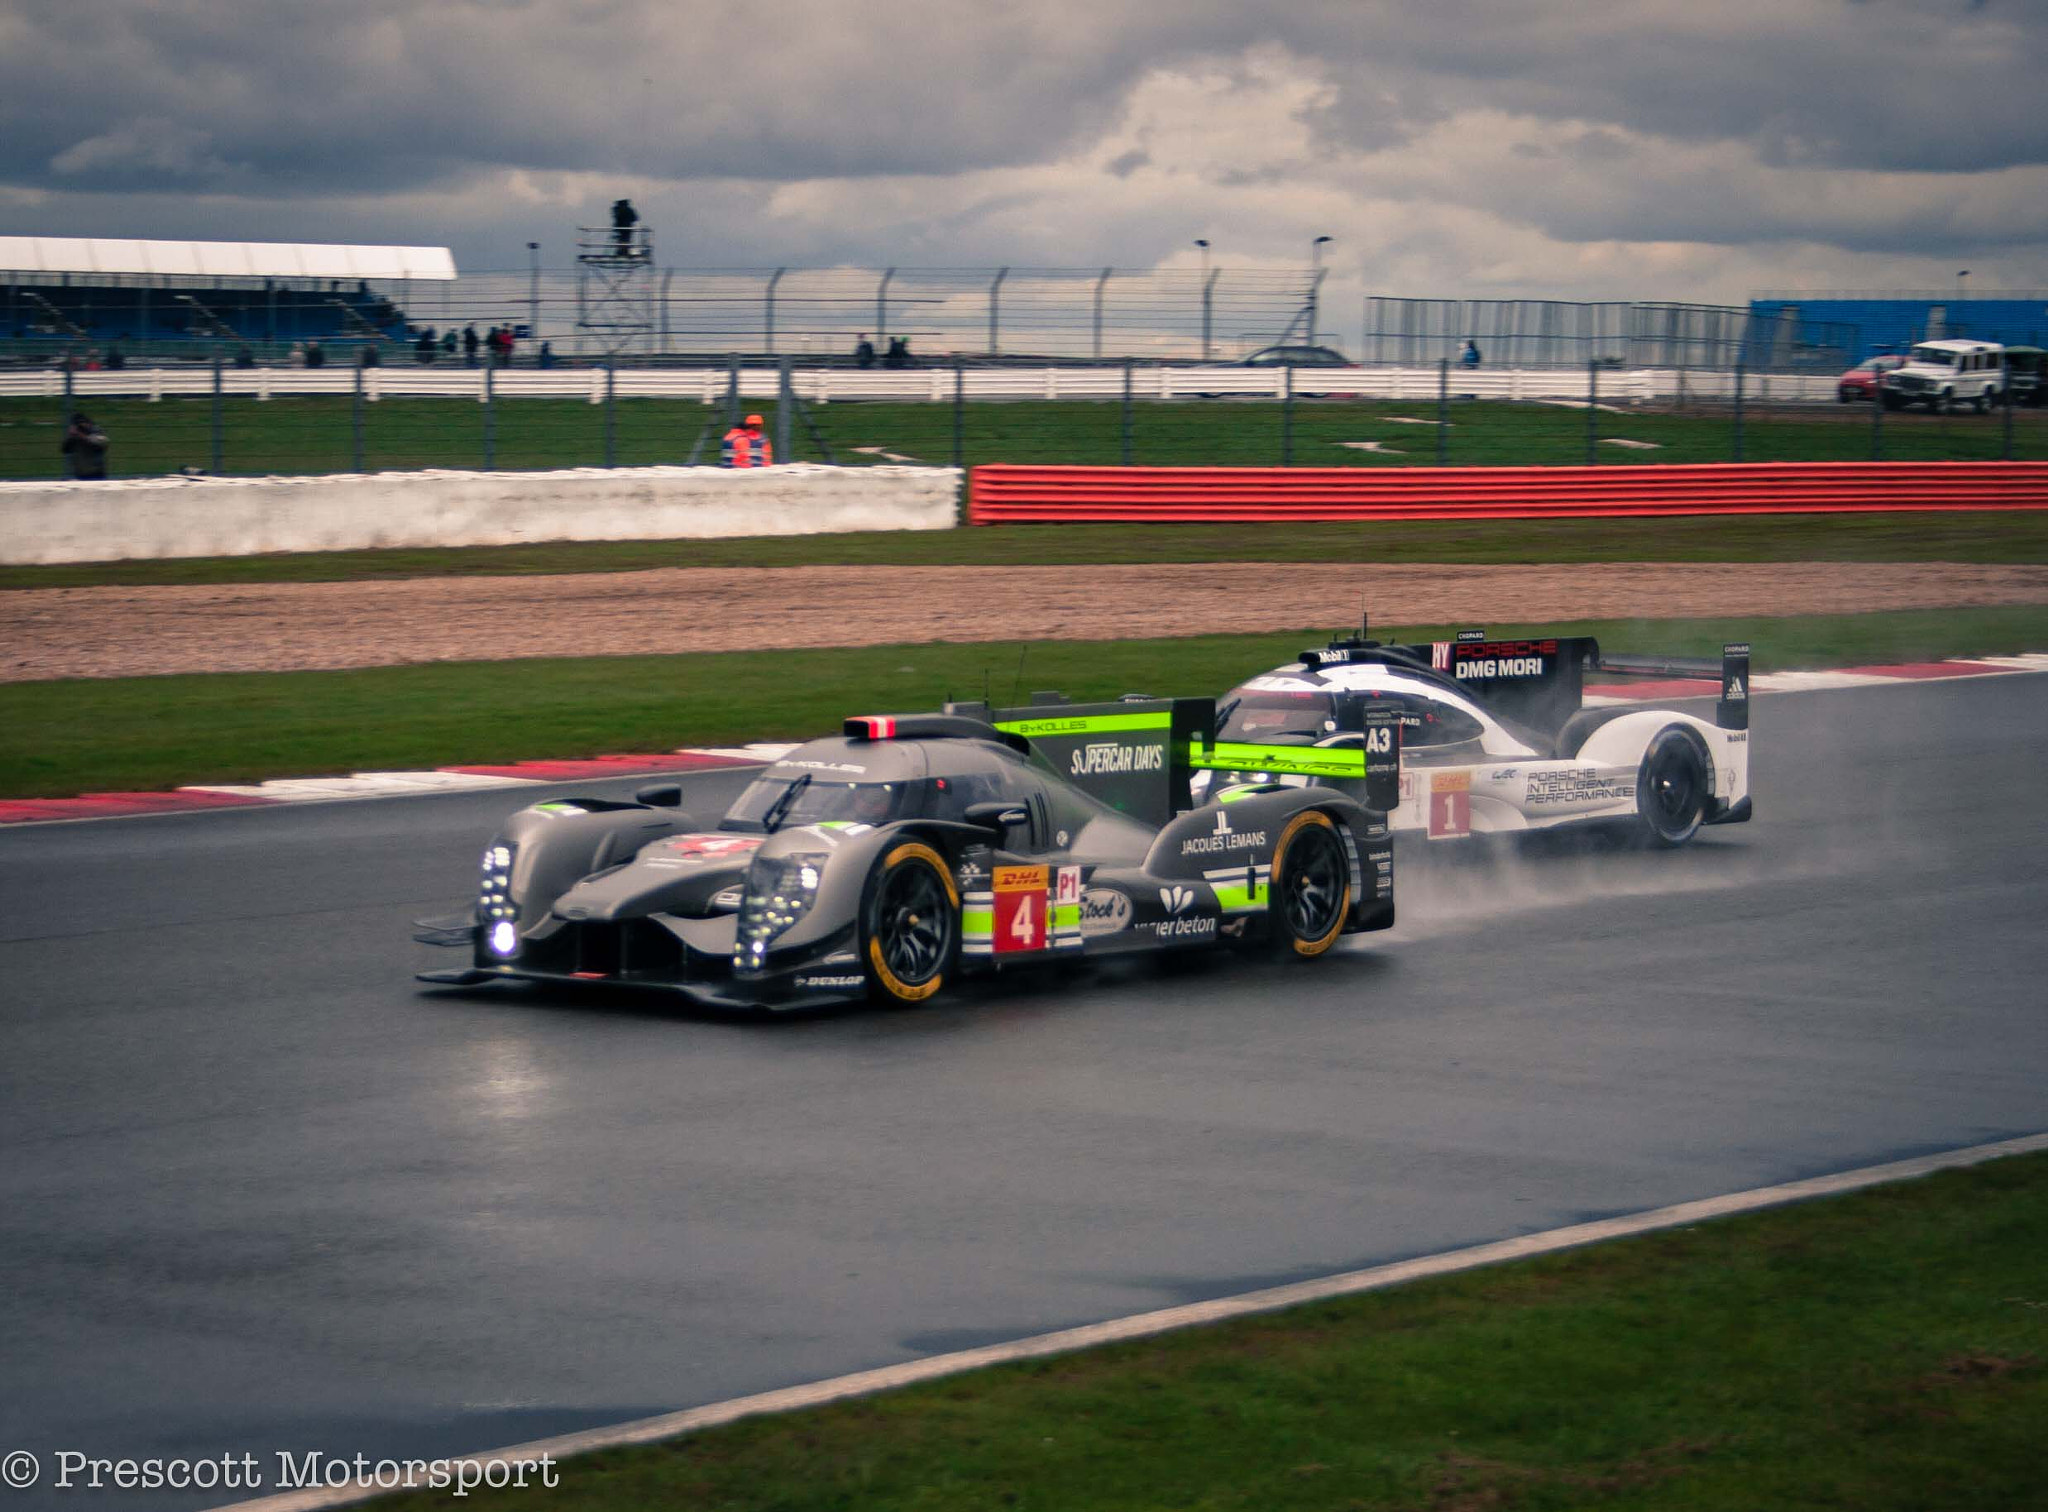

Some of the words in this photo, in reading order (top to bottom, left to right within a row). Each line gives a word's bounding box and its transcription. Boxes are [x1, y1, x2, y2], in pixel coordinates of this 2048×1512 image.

[1432, 642, 1449, 669] HY
[1456, 640, 1557, 657] PORSCHE
[1456, 660, 1496, 679] DMG
[1498, 658, 1542, 676] MORI
[1366, 727, 1391, 753] A3
[1071, 742, 1132, 775] SUPERCAR
[1134, 744, 1163, 770] DAYS
[1527, 778, 1615, 794] INTELLIGENT
[1528, 768, 1596, 782] PORSCHE
[1525, 786, 1635, 805] PERFORMANCE
[1443, 793, 1457, 830] 1
[1181, 835, 1224, 855] JACQUES
[1226, 831, 1266, 849] LEMANS
[1001, 870, 1040, 886] DHL
[1060, 872, 1077, 900] P1
[1011, 895, 1035, 945] 4
[806, 975, 865, 986] DUNLOP
